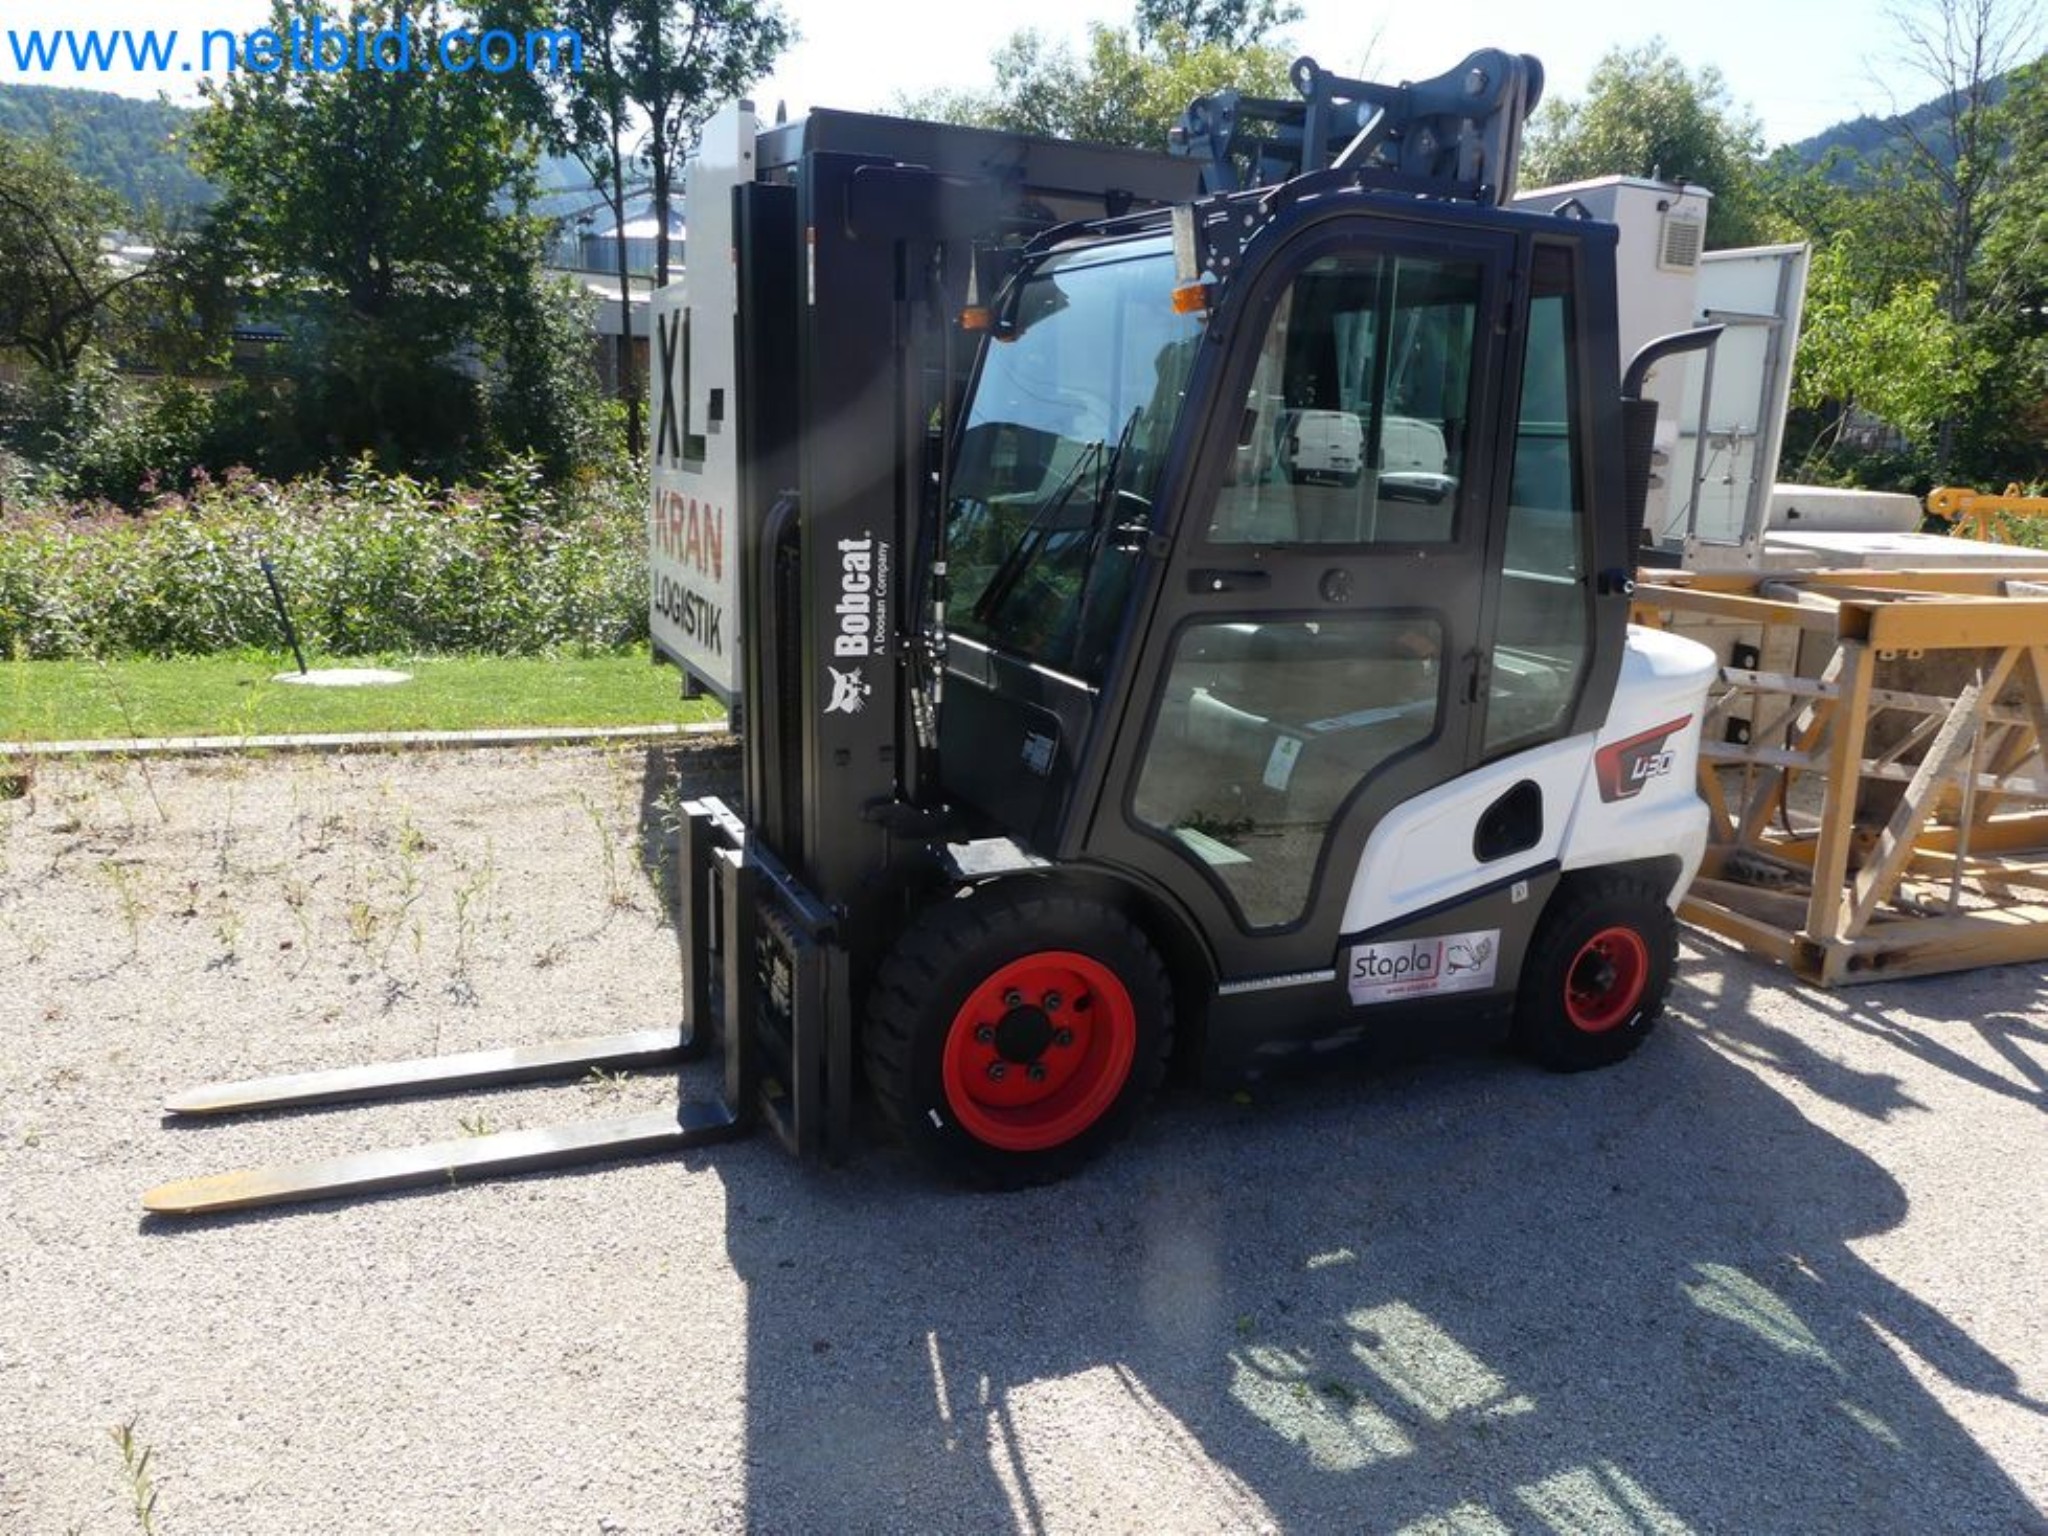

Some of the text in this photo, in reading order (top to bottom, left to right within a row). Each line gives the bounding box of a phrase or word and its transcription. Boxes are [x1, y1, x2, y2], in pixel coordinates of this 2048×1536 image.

[655, 486, 722, 583] KRAN
[654, 568, 722, 656] LOGISTIK
[834, 538, 872, 657] Bobcat
[873, 541, 891, 655] A Doosan Company
